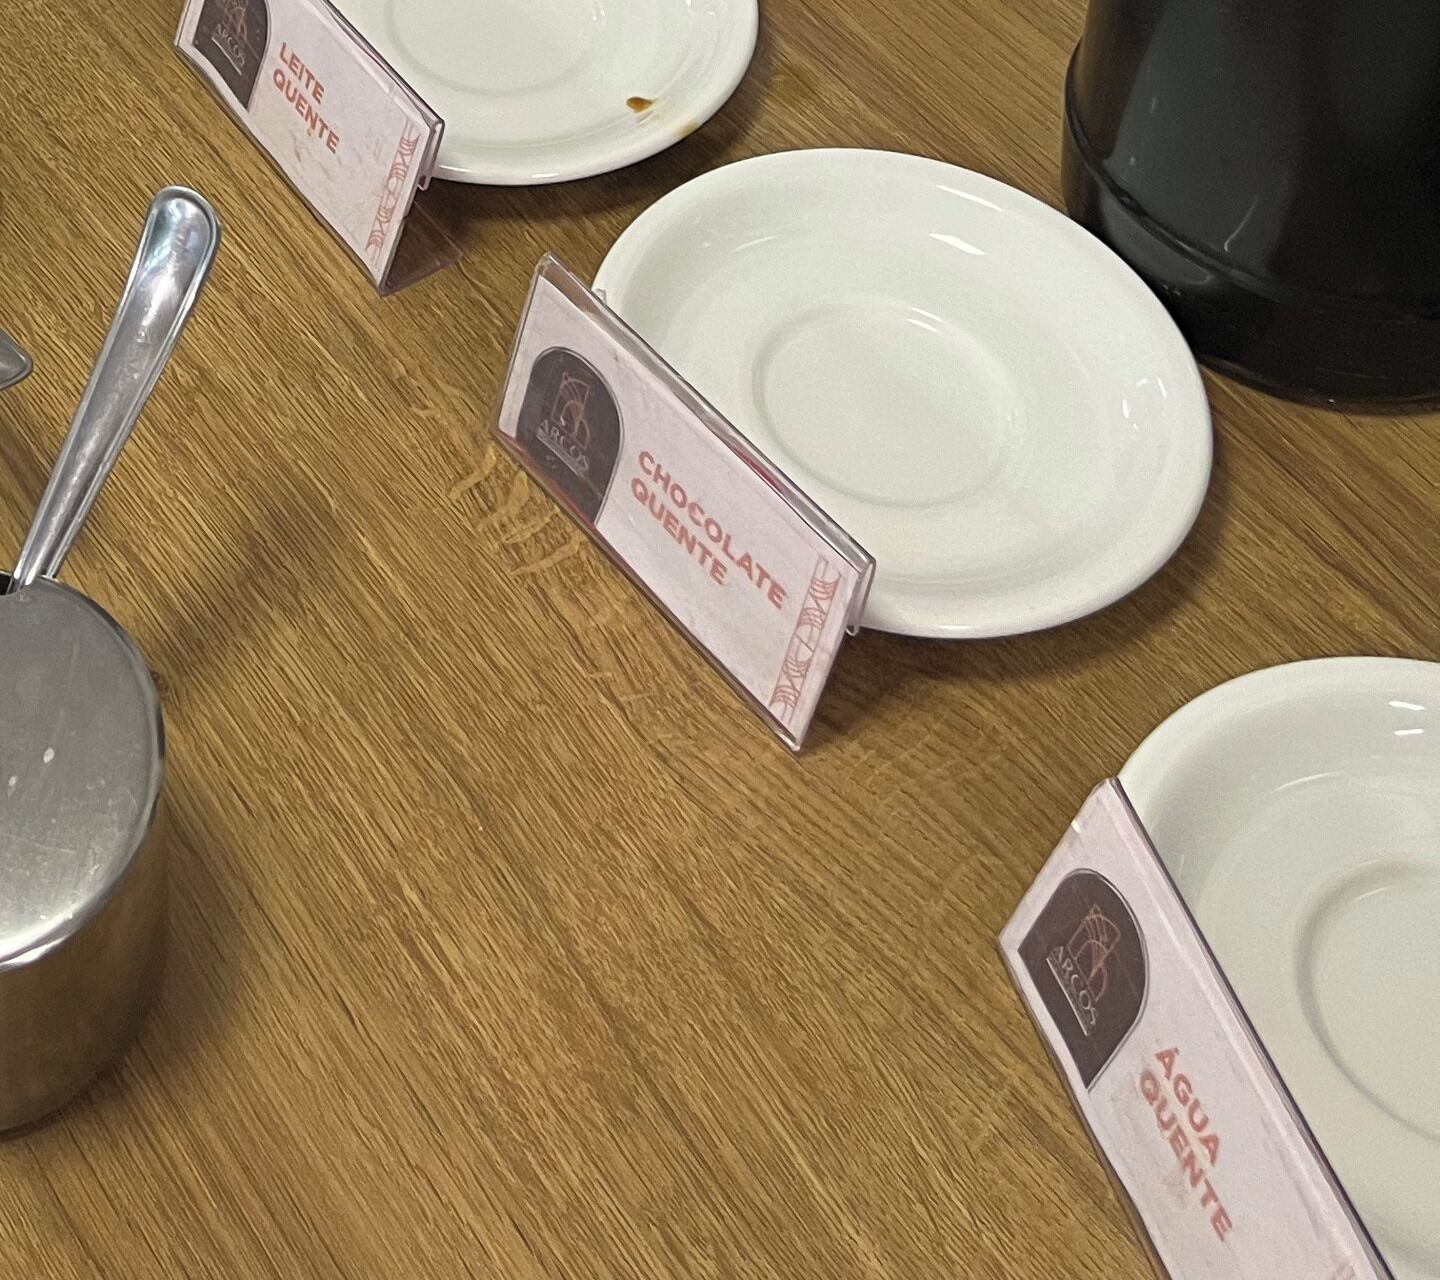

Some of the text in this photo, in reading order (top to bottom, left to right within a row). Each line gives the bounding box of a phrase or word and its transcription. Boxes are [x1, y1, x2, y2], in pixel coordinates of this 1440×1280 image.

[273, 68, 340, 154] QUENTE
[279, 41, 325, 105] LEITE
[631, 477, 728, 587] QUENTE
[638, 450, 788, 610] CHOCOLATE
[1050, 945, 1100, 1026] ARCOS
[1140, 1069, 1233, 1243] QUENTE
